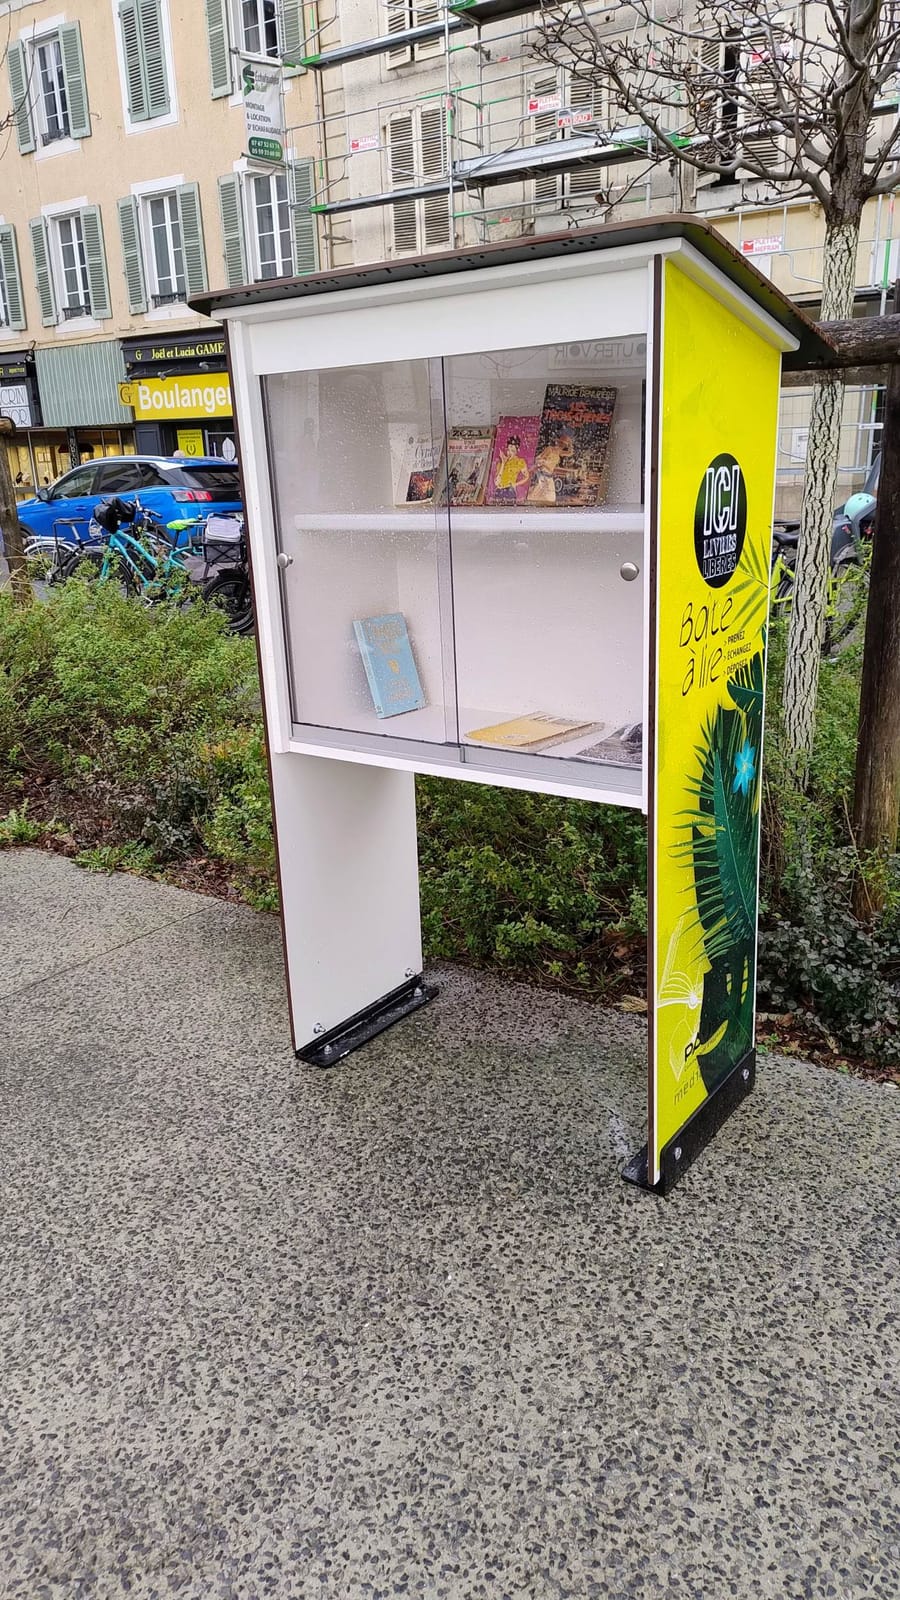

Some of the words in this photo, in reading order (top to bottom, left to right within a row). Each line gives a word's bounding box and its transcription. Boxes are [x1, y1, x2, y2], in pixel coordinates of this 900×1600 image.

[245, 101, 265, 112] MONTAGE
[250, 113, 272, 123] LOCATION
[151, 347, 166, 360] Joël
[166, 349, 174, 358] et
[175, 346, 196, 357] Lucia
[195, 342, 226, 356] GAME
[452, 429, 483, 438] ZOLA
[703, 464, 740, 536] ICI
[703, 533, 737, 559] LIVRES
[728, 630, 745, 645] PRENEZ
[698, 643, 723, 688] lire
